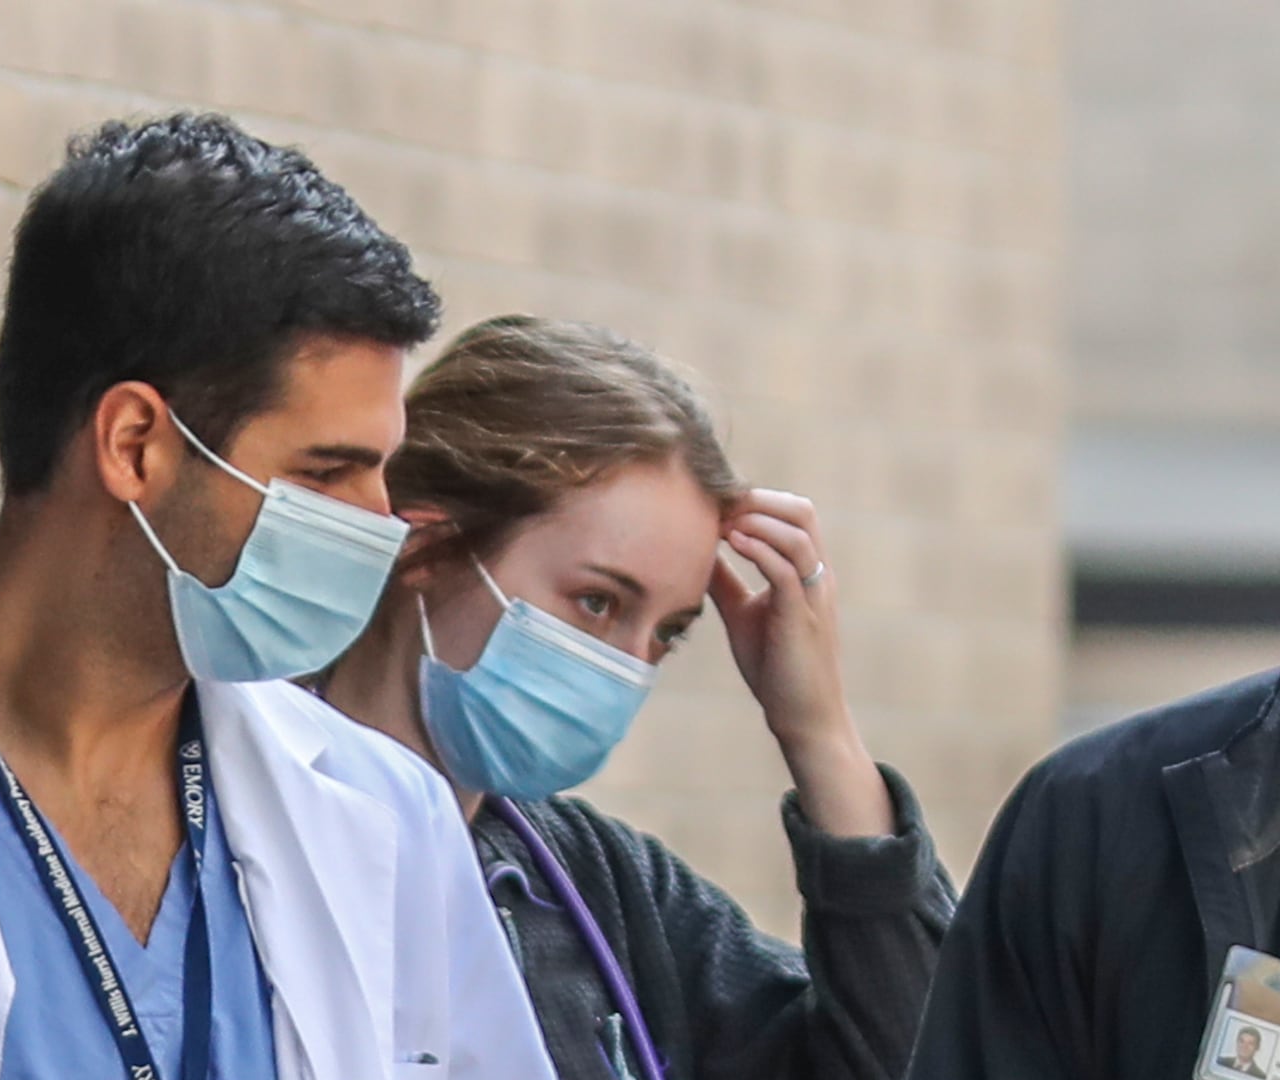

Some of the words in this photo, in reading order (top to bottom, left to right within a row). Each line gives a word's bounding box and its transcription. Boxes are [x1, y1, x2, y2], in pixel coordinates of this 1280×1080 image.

[182, 763, 204, 829] EMORY
[17, 799, 54, 856] Residency
[45, 854, 81, 908] Medicine
[67, 906, 103, 956] Internal
[92, 953, 118, 991] Hurst
[108, 988, 133, 1027] Willis
[121, 1023, 138, 1036] J.
